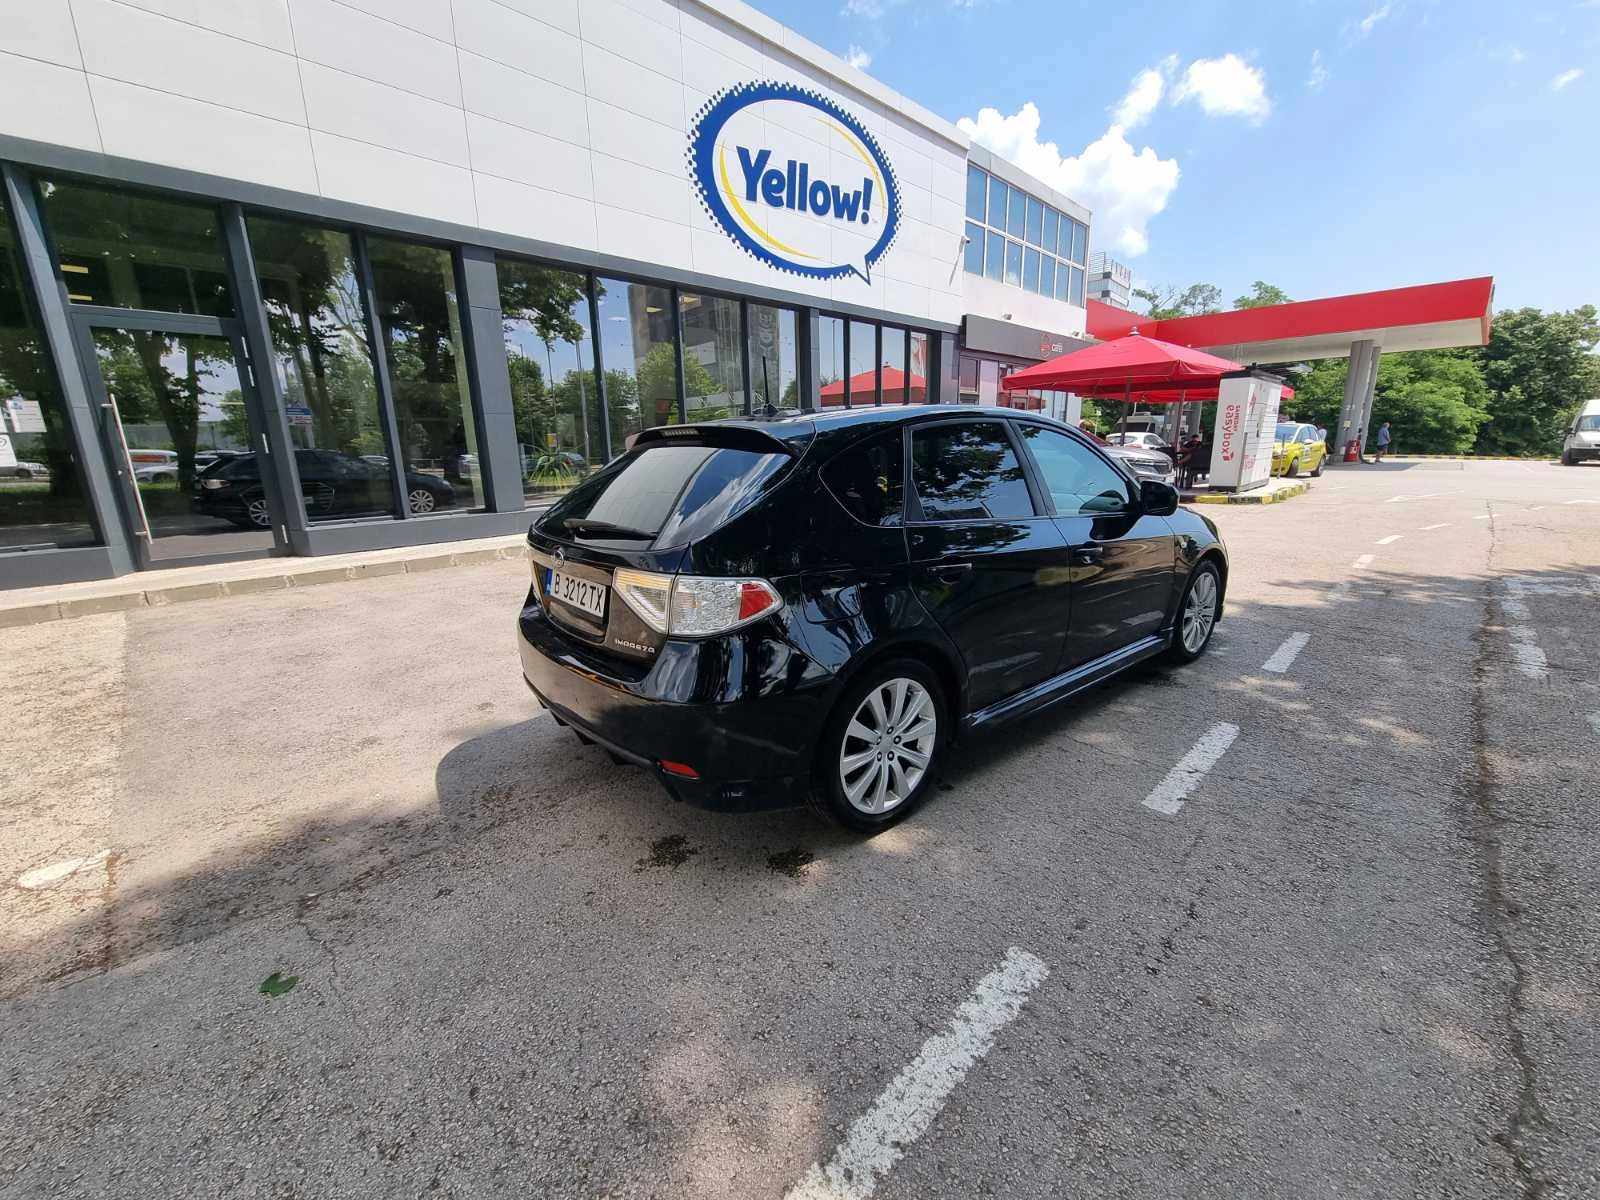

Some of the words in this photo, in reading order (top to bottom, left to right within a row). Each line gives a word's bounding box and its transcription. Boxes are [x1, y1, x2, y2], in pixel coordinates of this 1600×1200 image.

[736, 145, 873, 225] Yellow!
[1222, 404, 1235, 455] easybox
[563, 576, 588, 606] 3212
